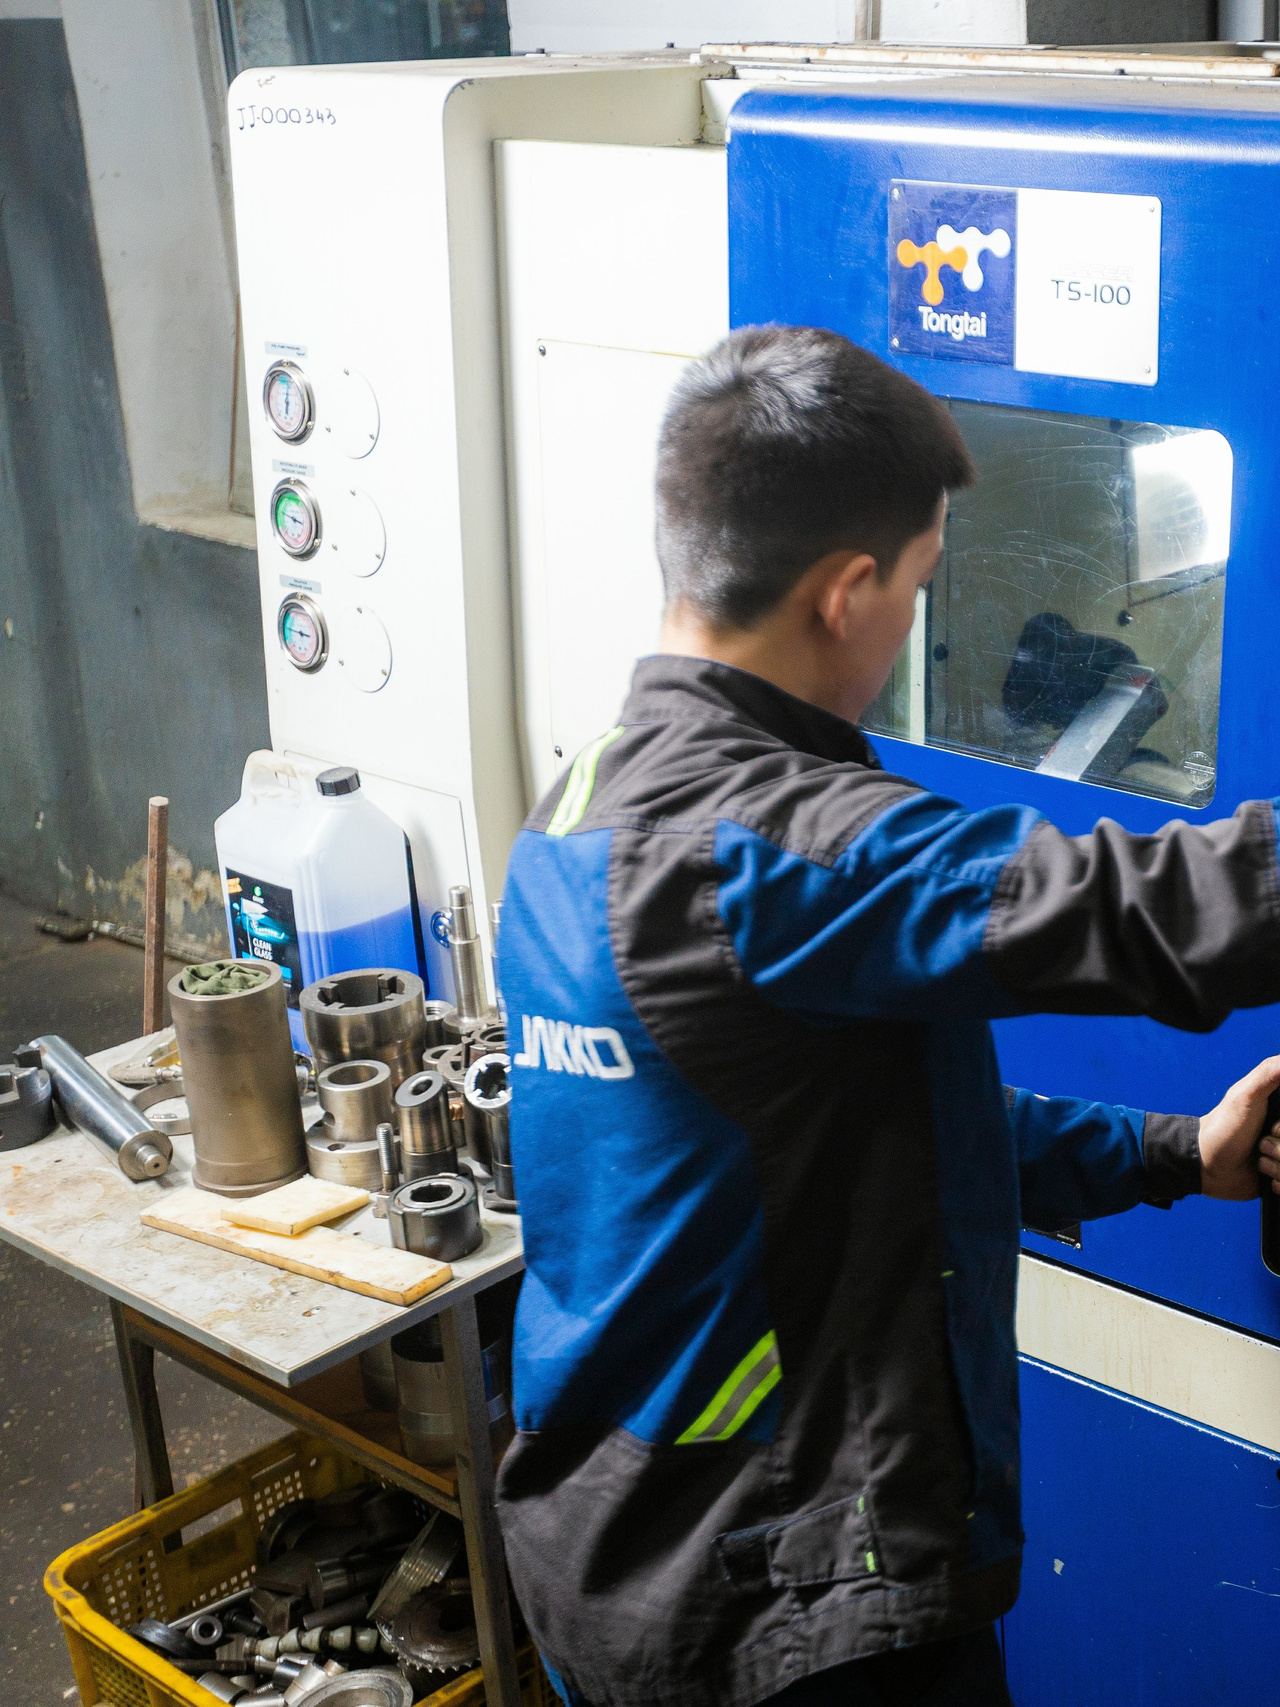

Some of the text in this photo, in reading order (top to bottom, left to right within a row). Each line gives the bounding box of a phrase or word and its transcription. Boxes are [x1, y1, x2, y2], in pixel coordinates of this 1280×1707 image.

[1050, 278, 1132, 306] TS-100
[918, 305, 988, 342] Tongtai
[252, 937, 273, 952] CLEAN
[253, 947, 274, 961] GLASS
